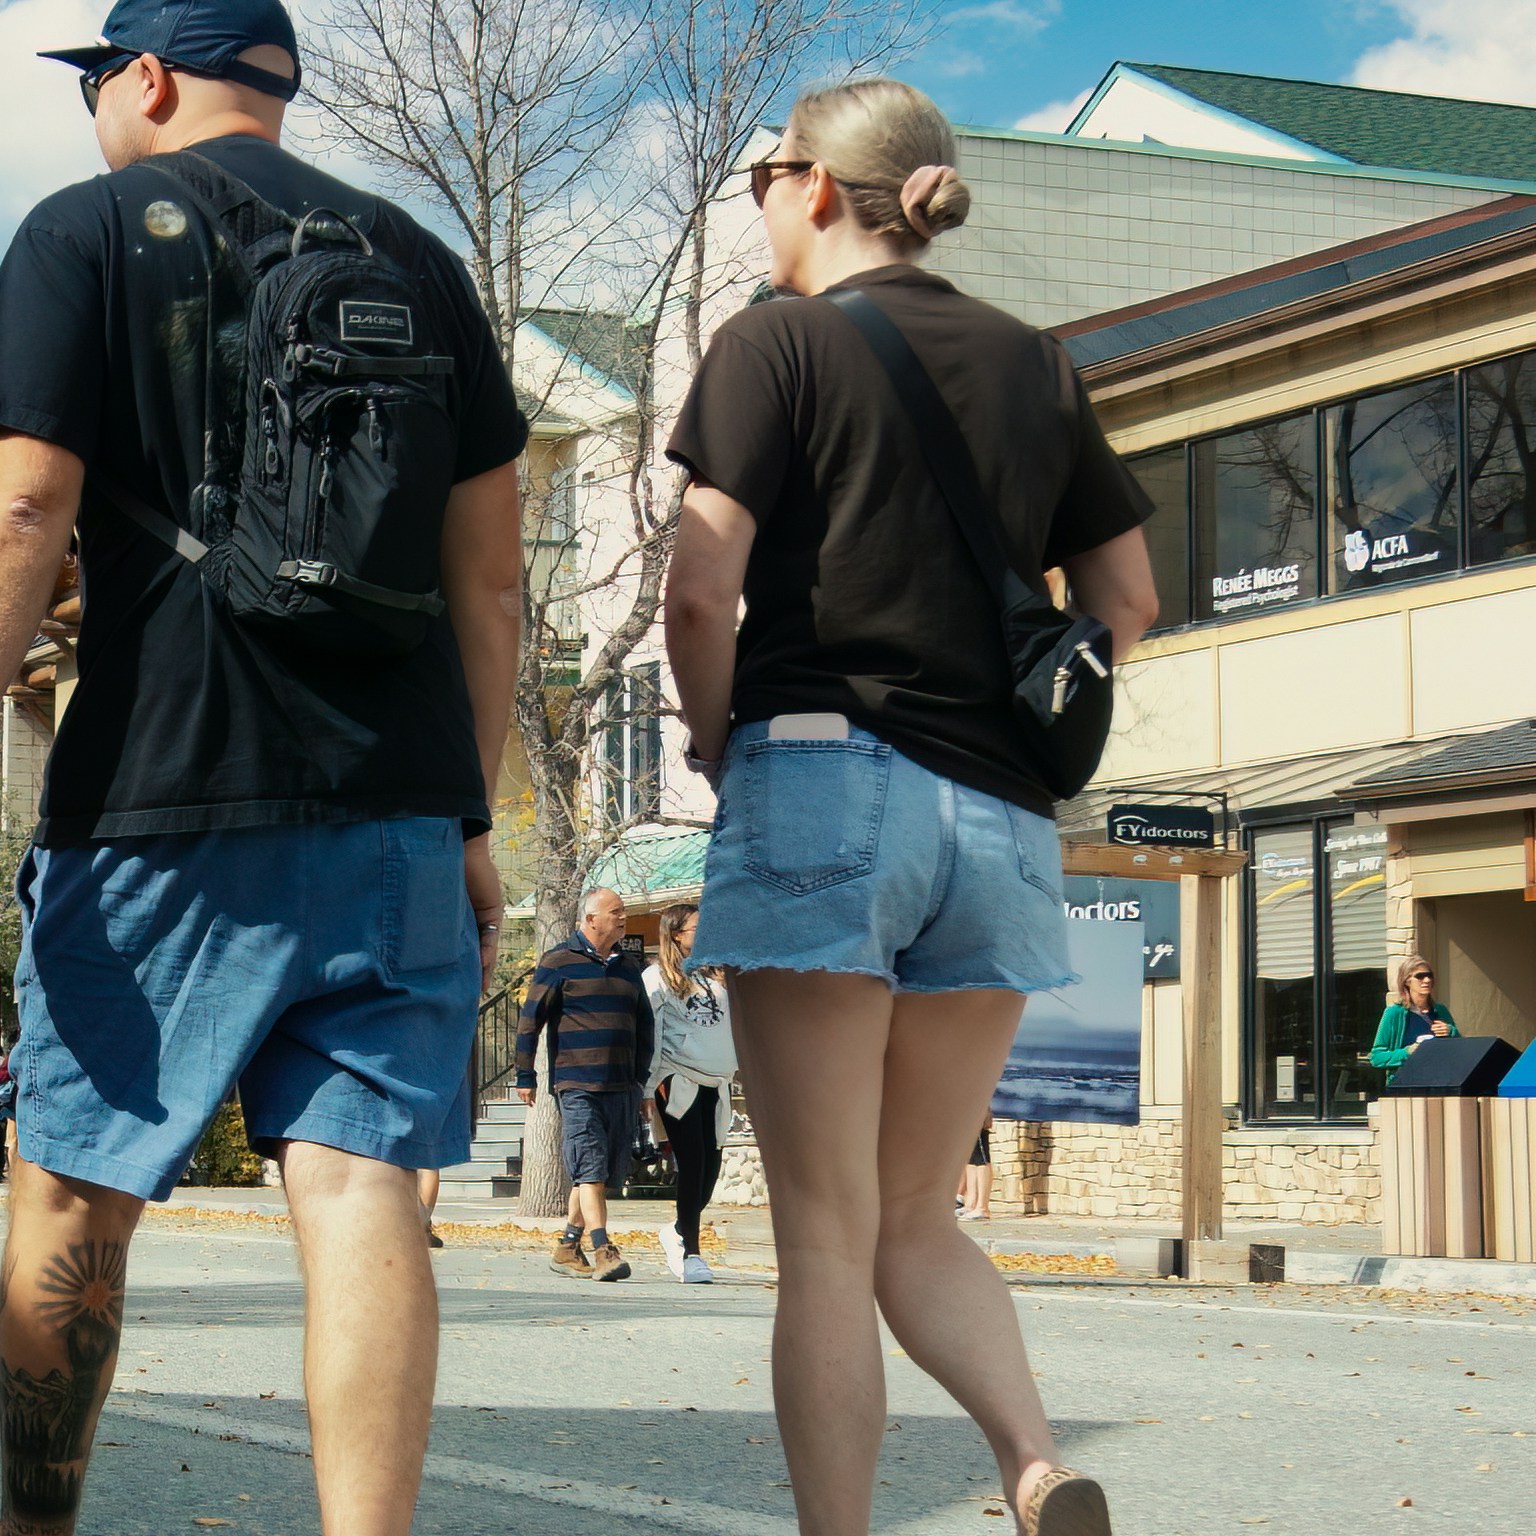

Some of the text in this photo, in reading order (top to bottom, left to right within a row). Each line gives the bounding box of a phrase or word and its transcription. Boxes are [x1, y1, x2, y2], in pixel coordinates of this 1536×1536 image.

[348, 315, 404, 327] DAKINE
[1372, 535, 1409, 560] ACFA
[1254, 564, 1299, 589] MEGGS
